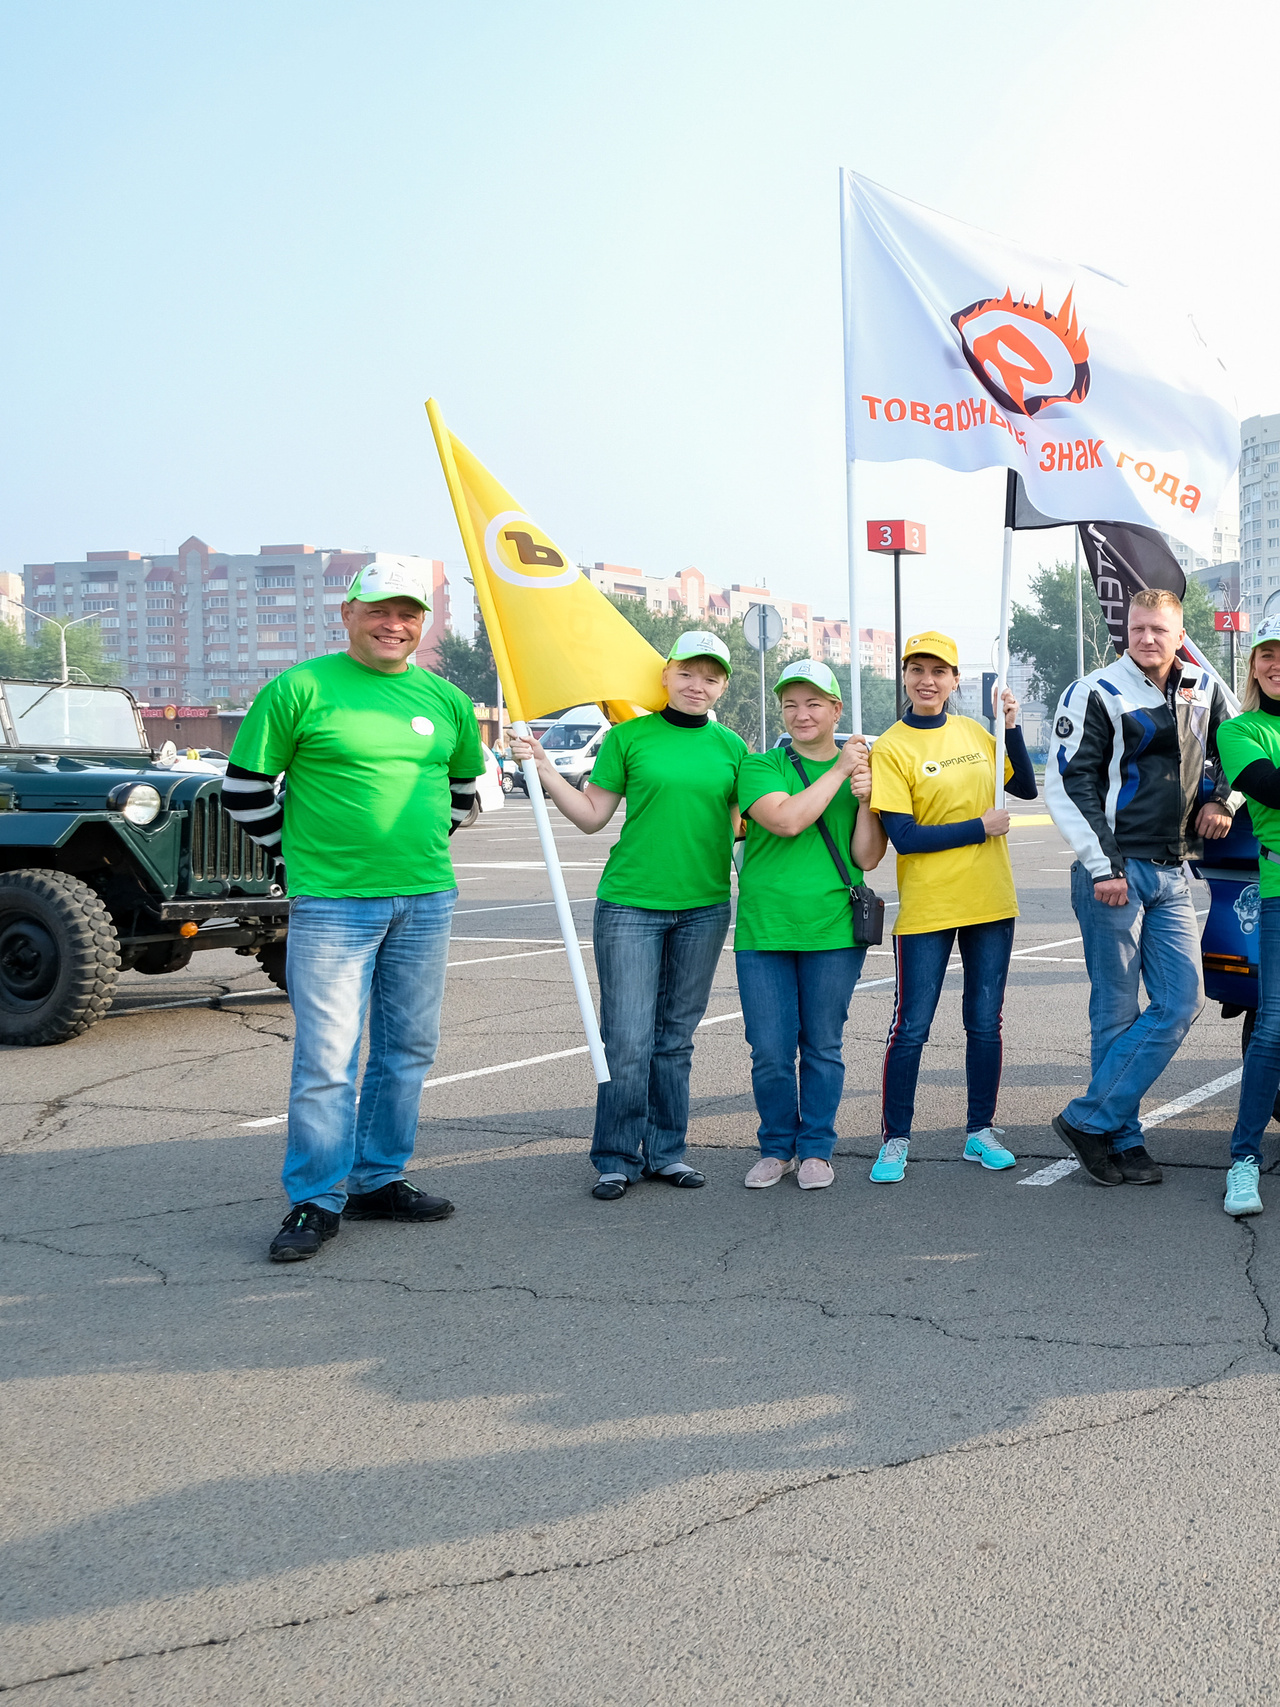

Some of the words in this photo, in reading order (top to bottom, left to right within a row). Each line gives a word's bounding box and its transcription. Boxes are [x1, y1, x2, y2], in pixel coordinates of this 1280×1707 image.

[1038, 438, 1106, 472] знак
[1116, 451, 1202, 514] года
[879, 525, 893, 547] 3
[911, 527, 920, 548] 3
[1222, 615, 1232, 629] 2
[177, 707, 209, 718] döner
[940, 752, 981, 768] ЯРПАТЕНТ
